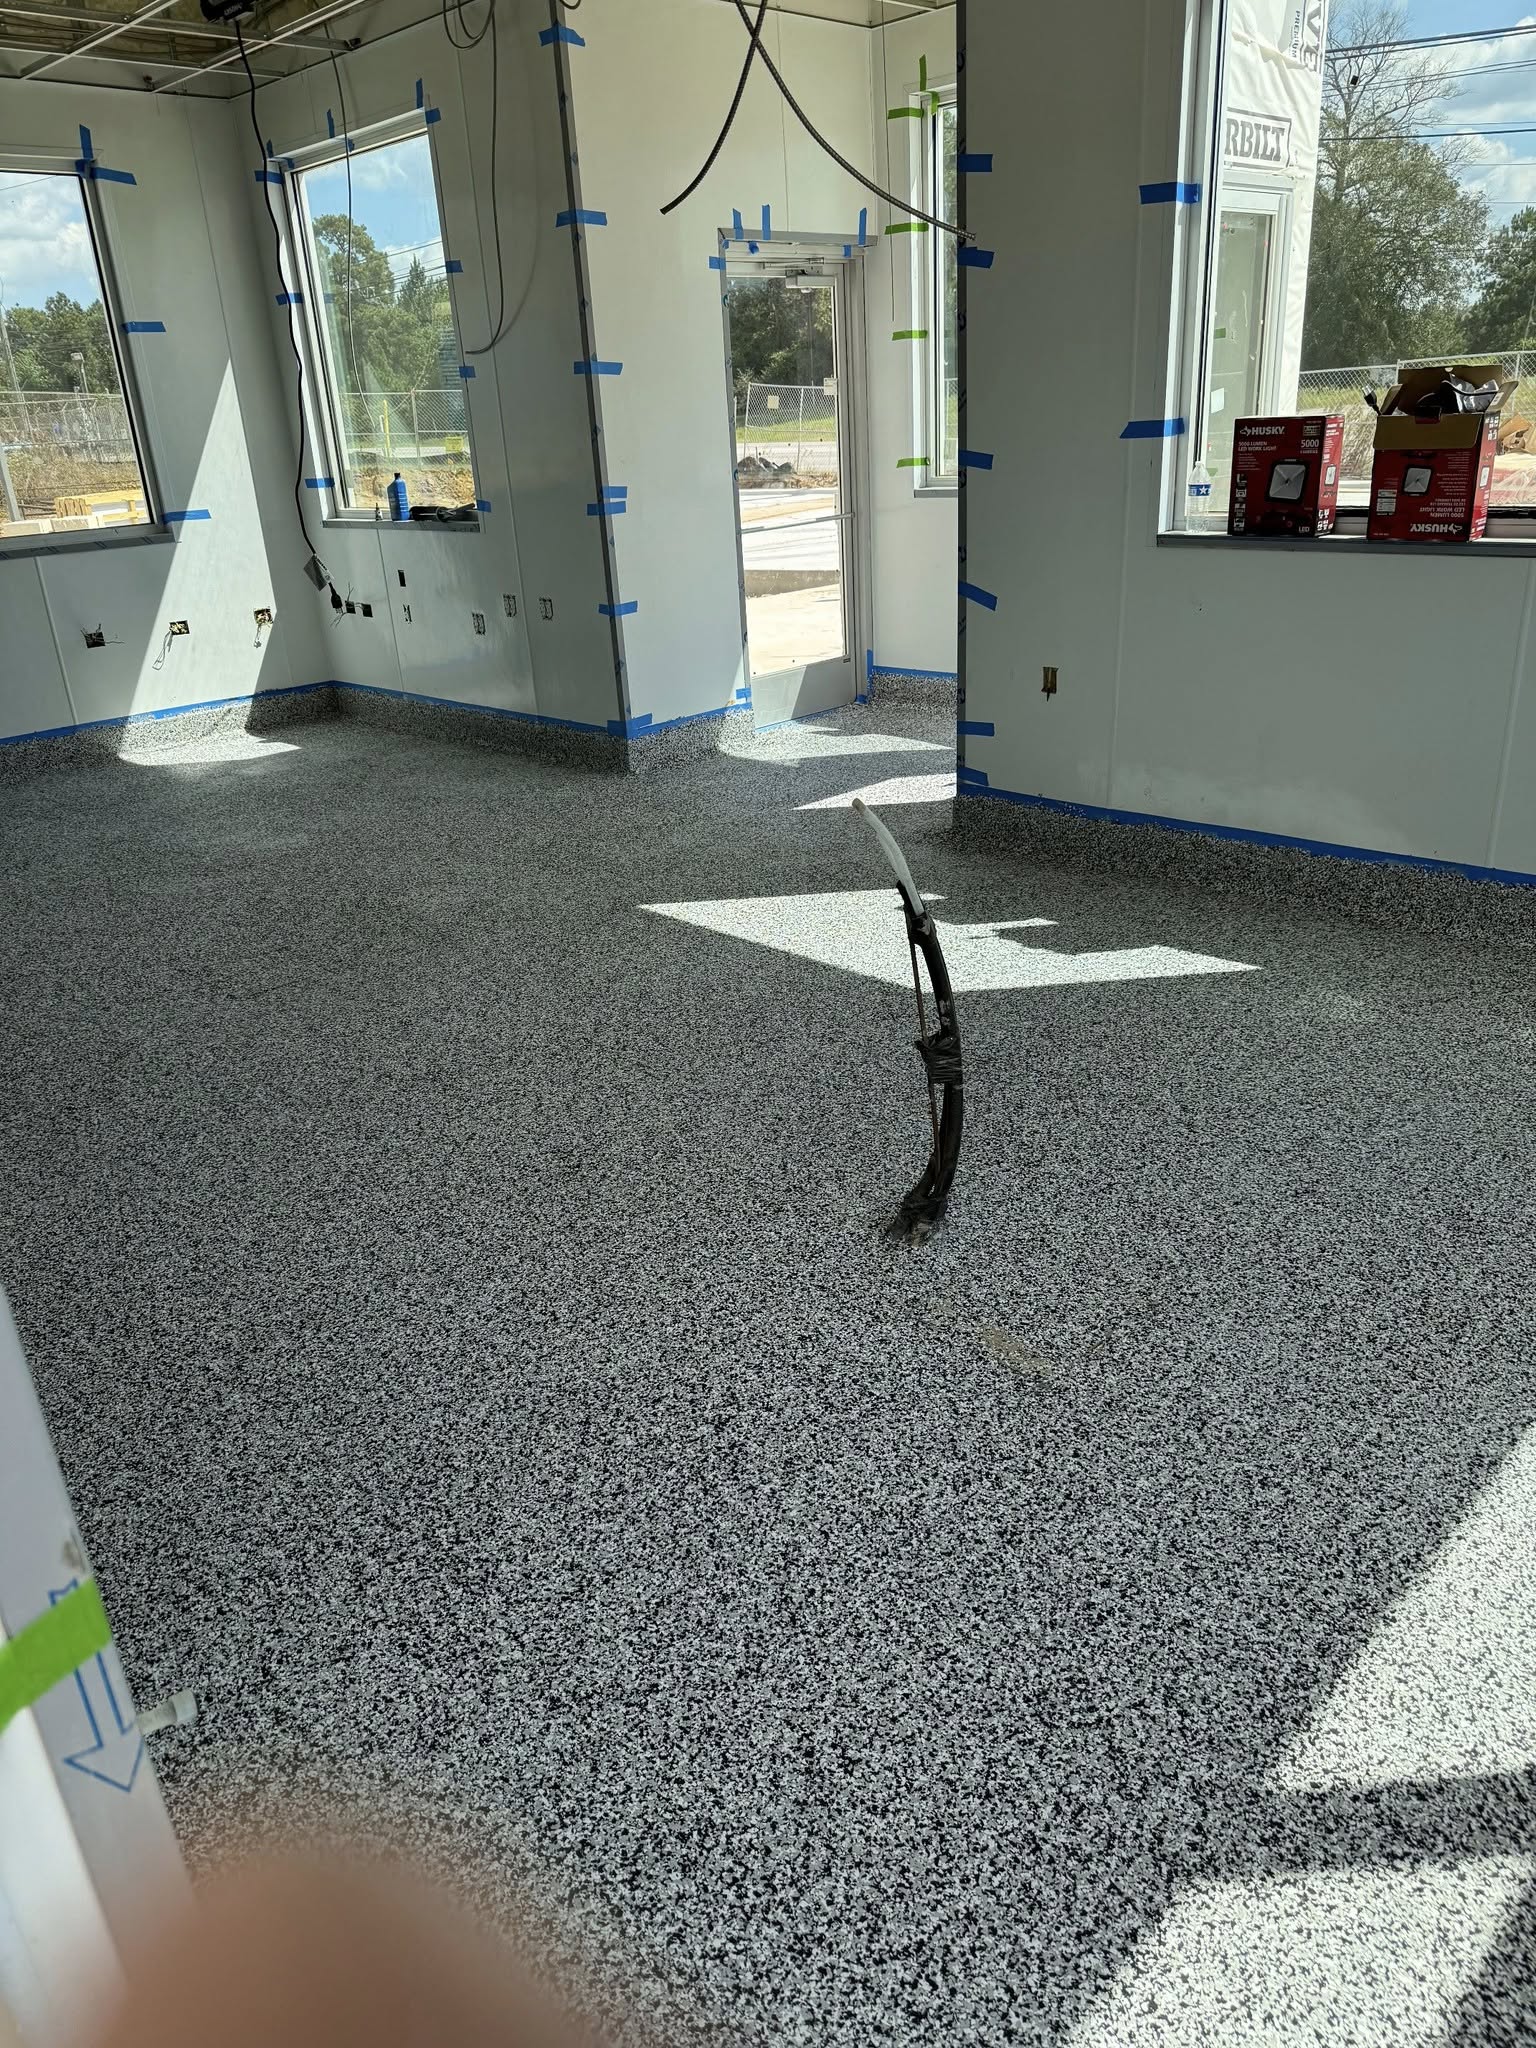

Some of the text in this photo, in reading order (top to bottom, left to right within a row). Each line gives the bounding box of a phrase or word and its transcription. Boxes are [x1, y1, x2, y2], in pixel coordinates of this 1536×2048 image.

[1291, 10, 1301, 58] PREMIUM
[1251, 426, 1285, 435] HUSKY
[1301, 439, 1319, 448] 5000
[1410, 523, 1449, 533] HUSKY
